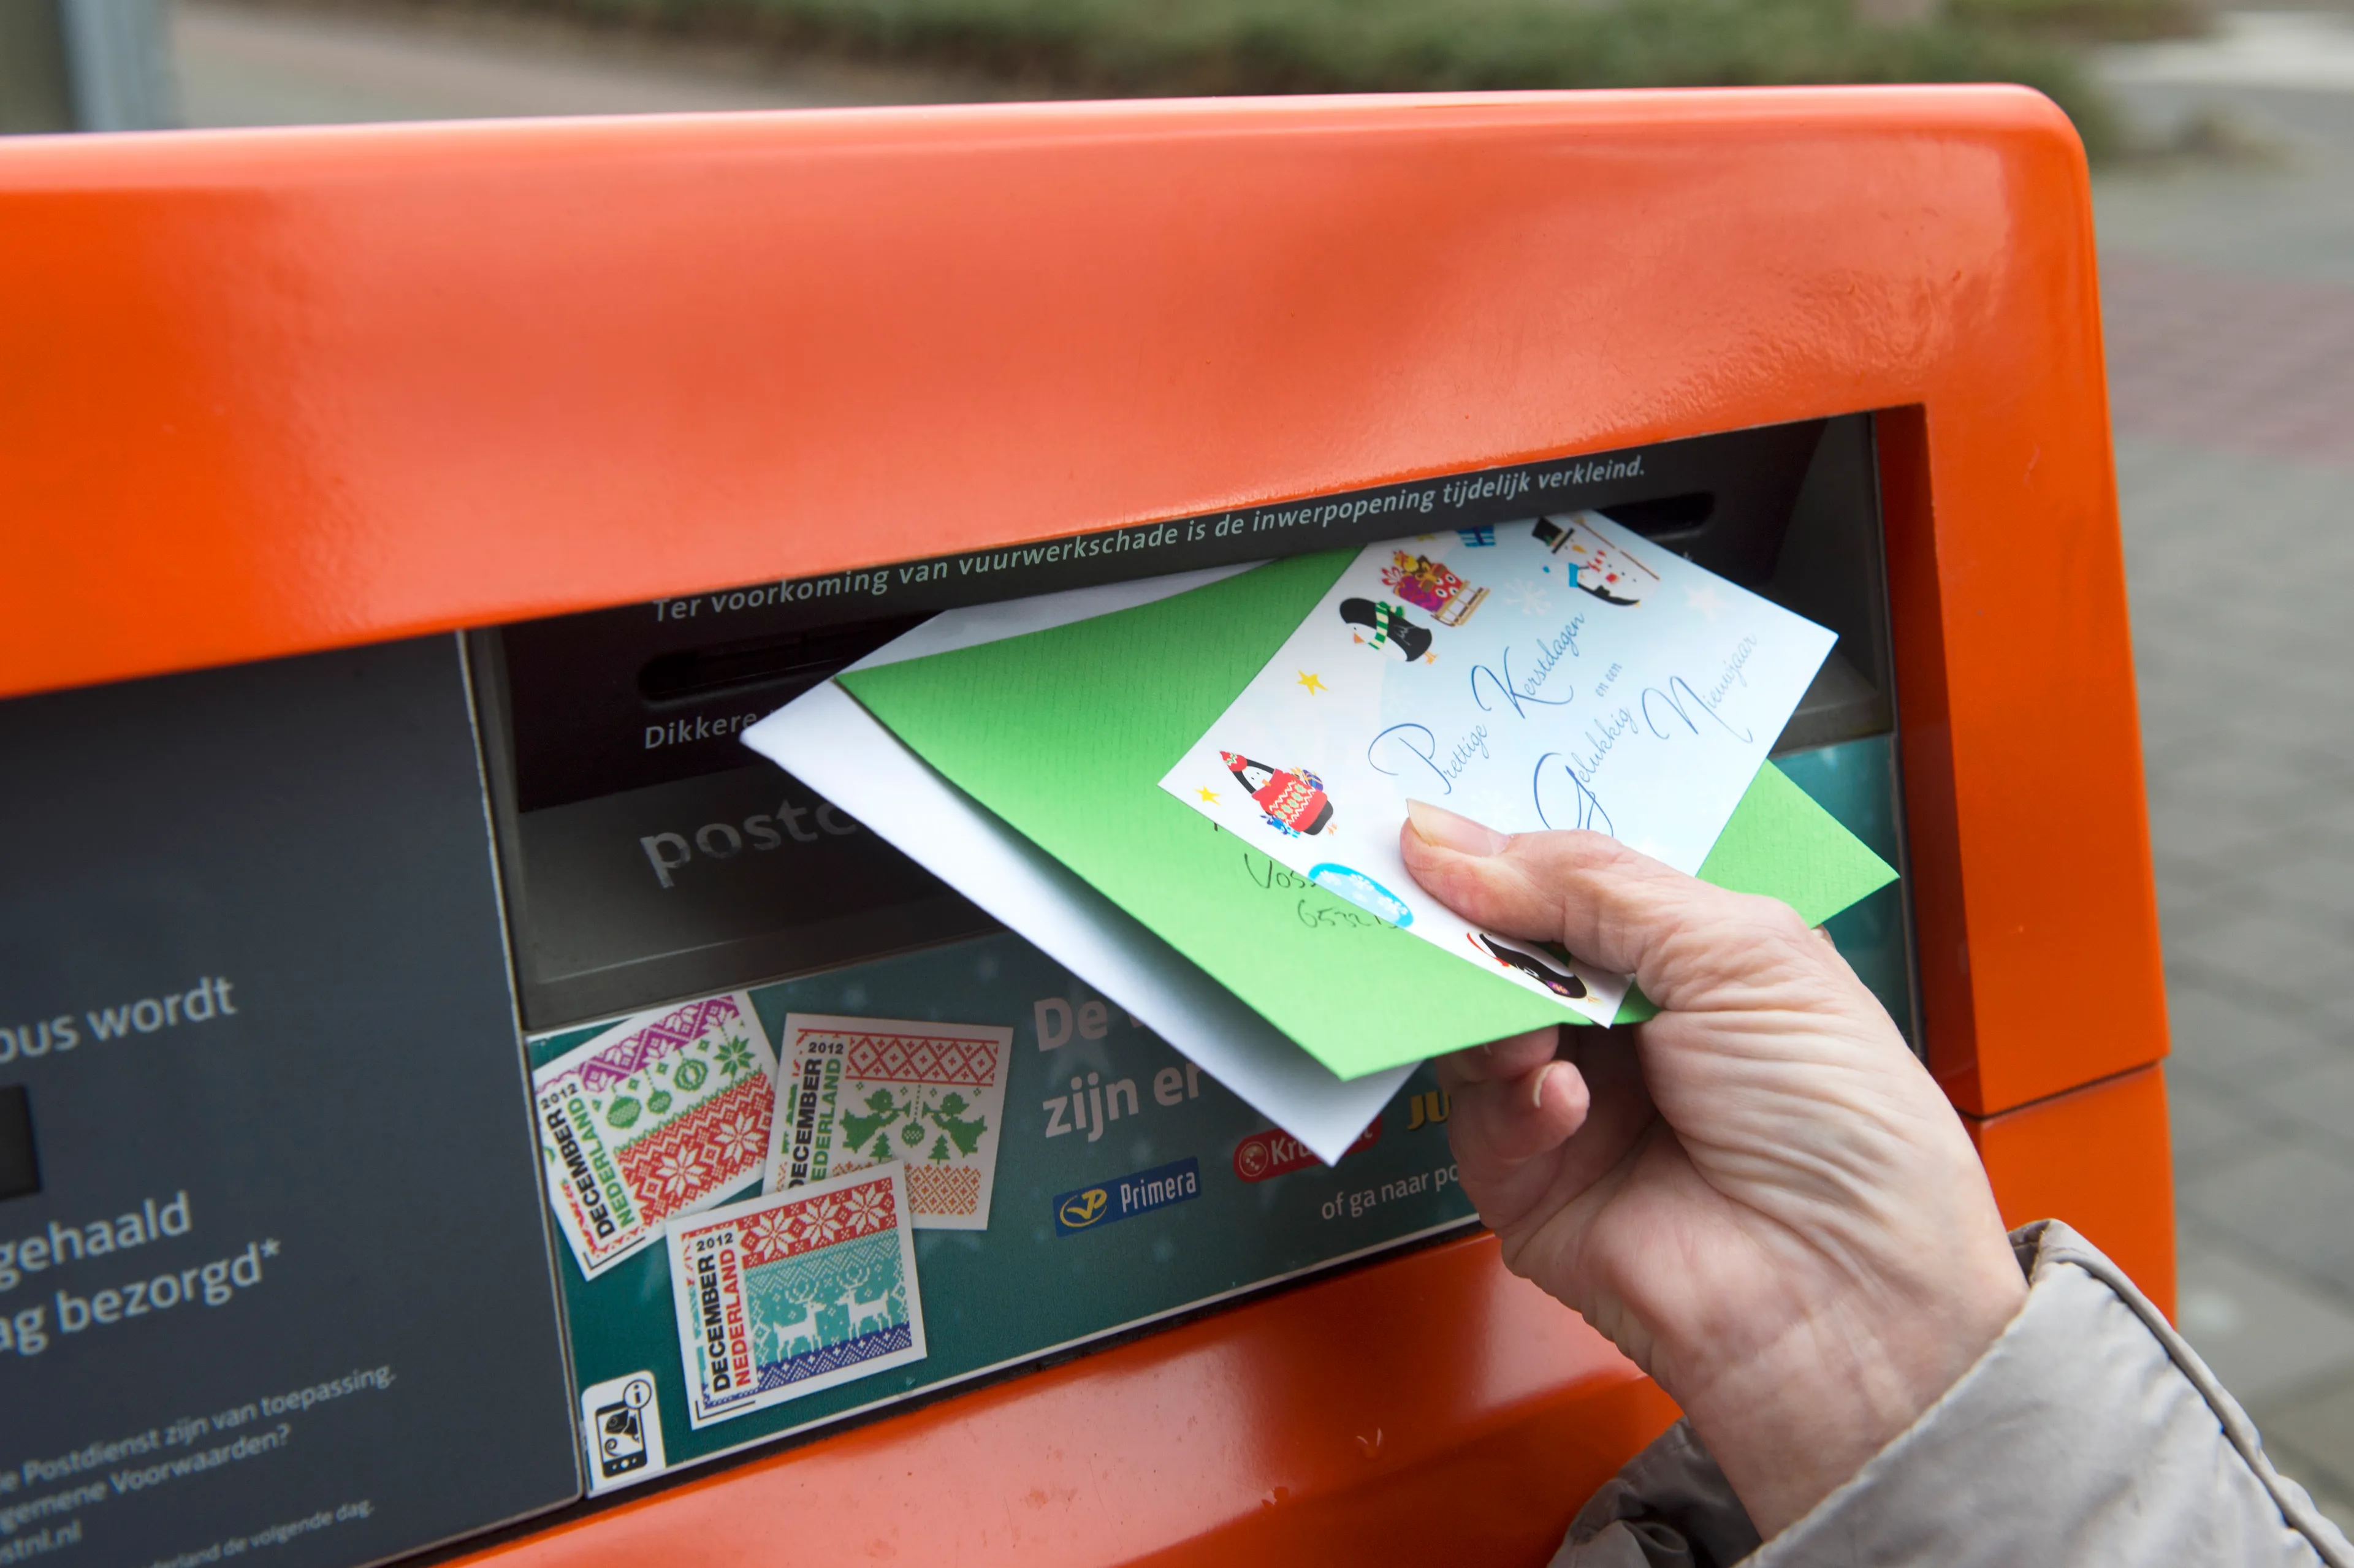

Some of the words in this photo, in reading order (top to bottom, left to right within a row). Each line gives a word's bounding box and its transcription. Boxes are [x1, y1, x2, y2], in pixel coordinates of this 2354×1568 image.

[653, 597, 701, 622] Ter
[711, 570, 889, 612] voorkoming
[899, 561, 948, 584] van
[959, 524, 1179, 575] vuurwerkschade
[1187, 520, 1206, 541] is
[1215, 514, 1244, 537] de
[1252, 489, 1436, 531] inwerpopening
[1442, 471, 1531, 508] tijdelijk
[1537, 454, 1645, 490] verkleind.
[1368, 722, 1490, 795] Prettige
[1471, 612, 1585, 720] Kerstdagen
[1595, 682, 1609, 698] en
[1606, 663, 1623, 682] een
[644, 712, 758, 750] Dikkere
[1533, 707, 1639, 837] Gelukkig
[1641, 632, 1758, 744] Nieuwjaar
[86, 976, 238, 1041] wordt
[1033, 997, 1108, 1052] De
[807, 1041, 844, 1055] 2012
[539, 1082, 579, 1110] 2012
[1042, 1071, 1139, 1143] zijn
[546, 1107, 616, 1239] DECEMBER
[566, 1097, 636, 1228] NEDERLAND
[1120, 1171, 1197, 1213] Primera
[1321, 1190, 1345, 1220] of
[1350, 1190, 1377, 1219] ga
[1381, 1171, 1429, 1203] naar
[696, 1232, 734, 1252] 2012
[697, 1254, 731, 1393] DECEMBER
[719, 1248, 752, 1388] NEDERLAND
[21, 1428, 161, 1486] Postdienst
[164, 1415, 210, 1447] zijn
[211, 1402, 259, 1431] van
[260, 1364, 398, 1417] toepassing.
[109, 1421, 292, 1495] Voorwaarden?
[223, 1536, 246, 1557] de
[249, 1510, 334, 1545] volgende
